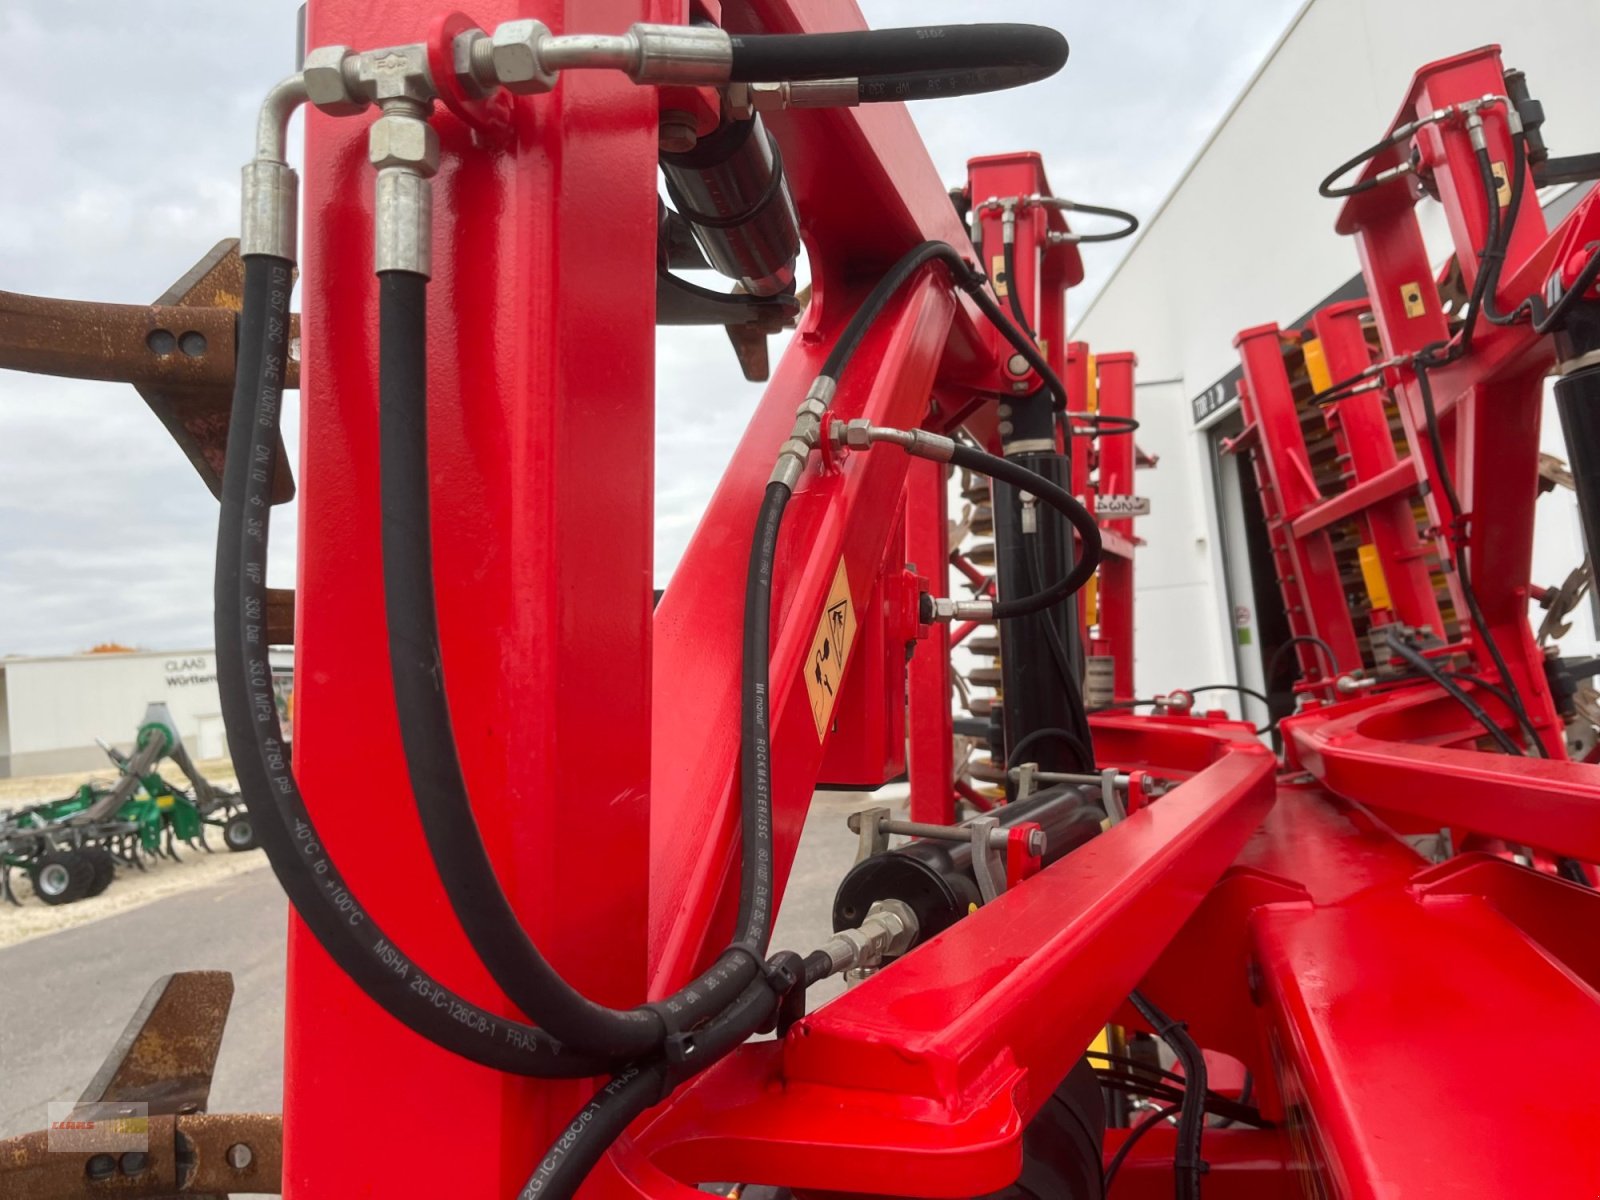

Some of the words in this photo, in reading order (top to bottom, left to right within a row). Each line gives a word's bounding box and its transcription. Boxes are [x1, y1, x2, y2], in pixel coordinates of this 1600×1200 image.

[272, 266, 287, 286] EN
[271, 288, 285, 314] 857
[267, 316, 284, 345] 2SC
[264, 354, 281, 381] SAE
[255, 445, 270, 466] DN
[252, 467, 267, 483] 10
[247, 562, 261, 585] WP
[246, 596, 260, 621] 330
[246, 623, 260, 645] bar
[165, 657, 206, 671] CLAAS
[249, 659, 267, 687] 33.0
[254, 691, 272, 722] MPa
[264, 737, 285, 770] 4780
[273, 774, 295, 794] psi
[294, 817, 320, 855] -40°C
[313, 859, 329, 875] to
[325, 879, 364, 926] +100°C
[373, 939, 409, 978] MSHA
[505, 1027, 538, 1052] FRAS
